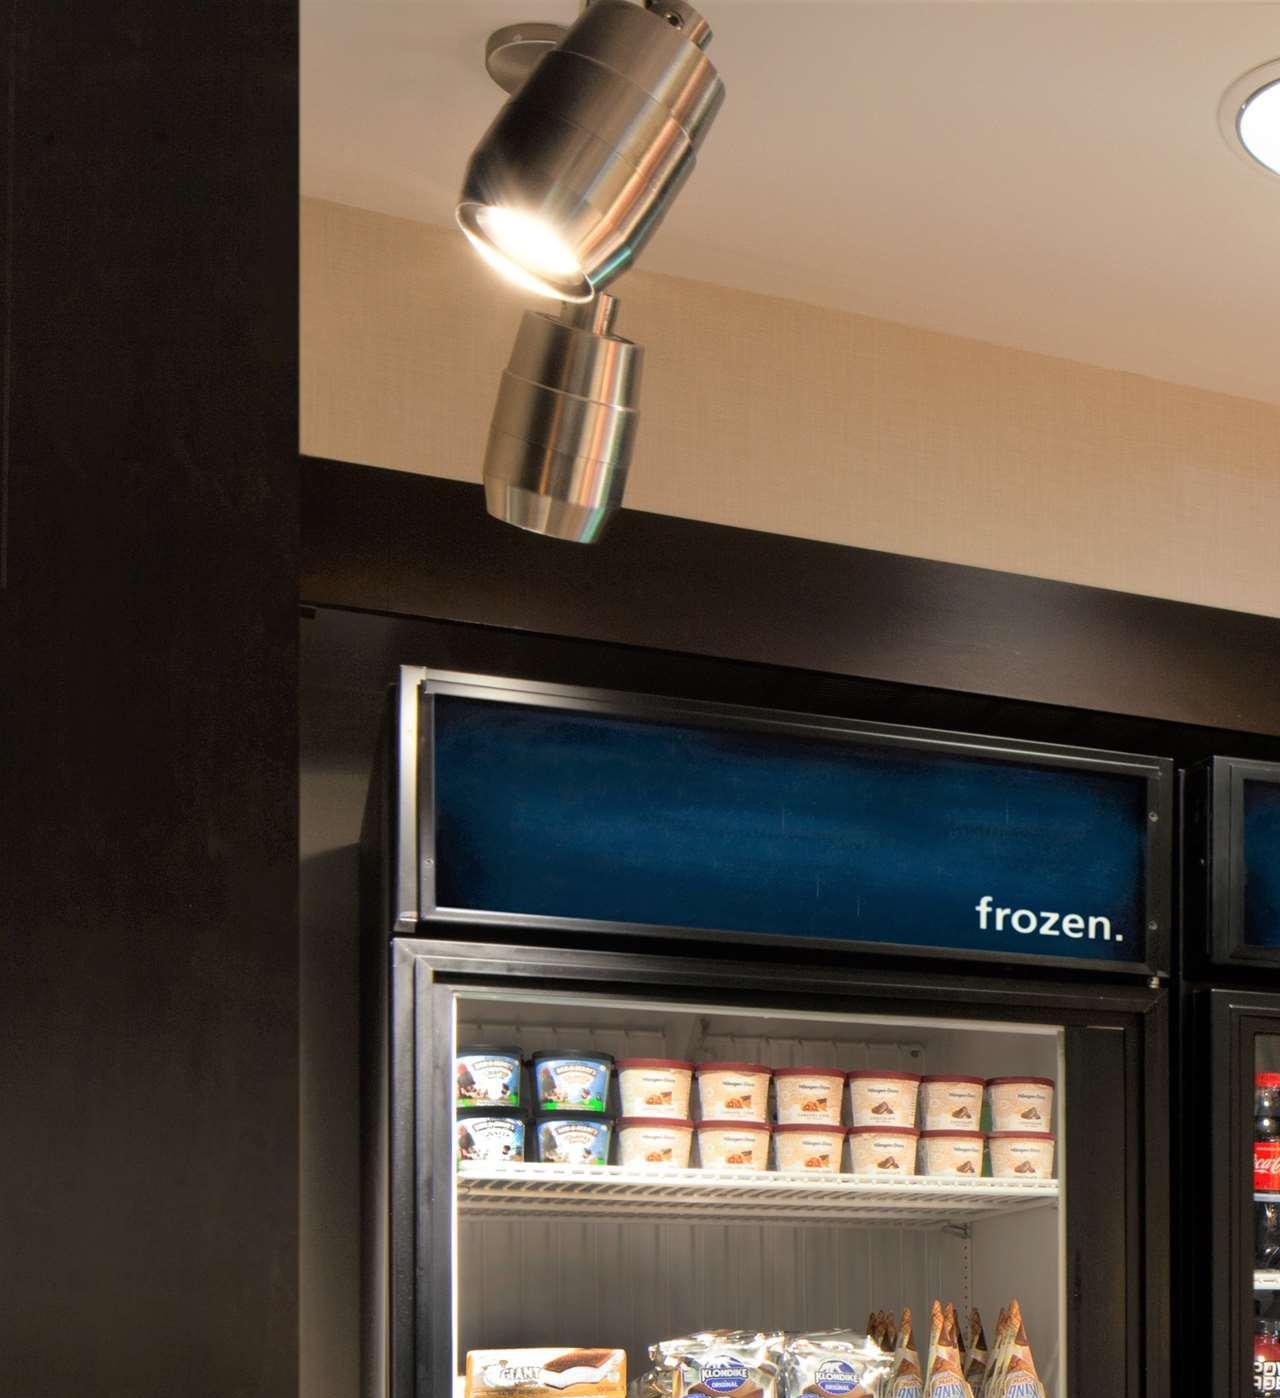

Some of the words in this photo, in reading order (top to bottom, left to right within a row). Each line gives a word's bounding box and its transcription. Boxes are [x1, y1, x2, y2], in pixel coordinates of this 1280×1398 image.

[975, 895, 1124, 942] frozen.
[501, 1367, 541, 1380] GIANT
[701, 1366, 749, 1380] KLONDIKE
[815, 1371, 860, 1384] KLONDIKE
